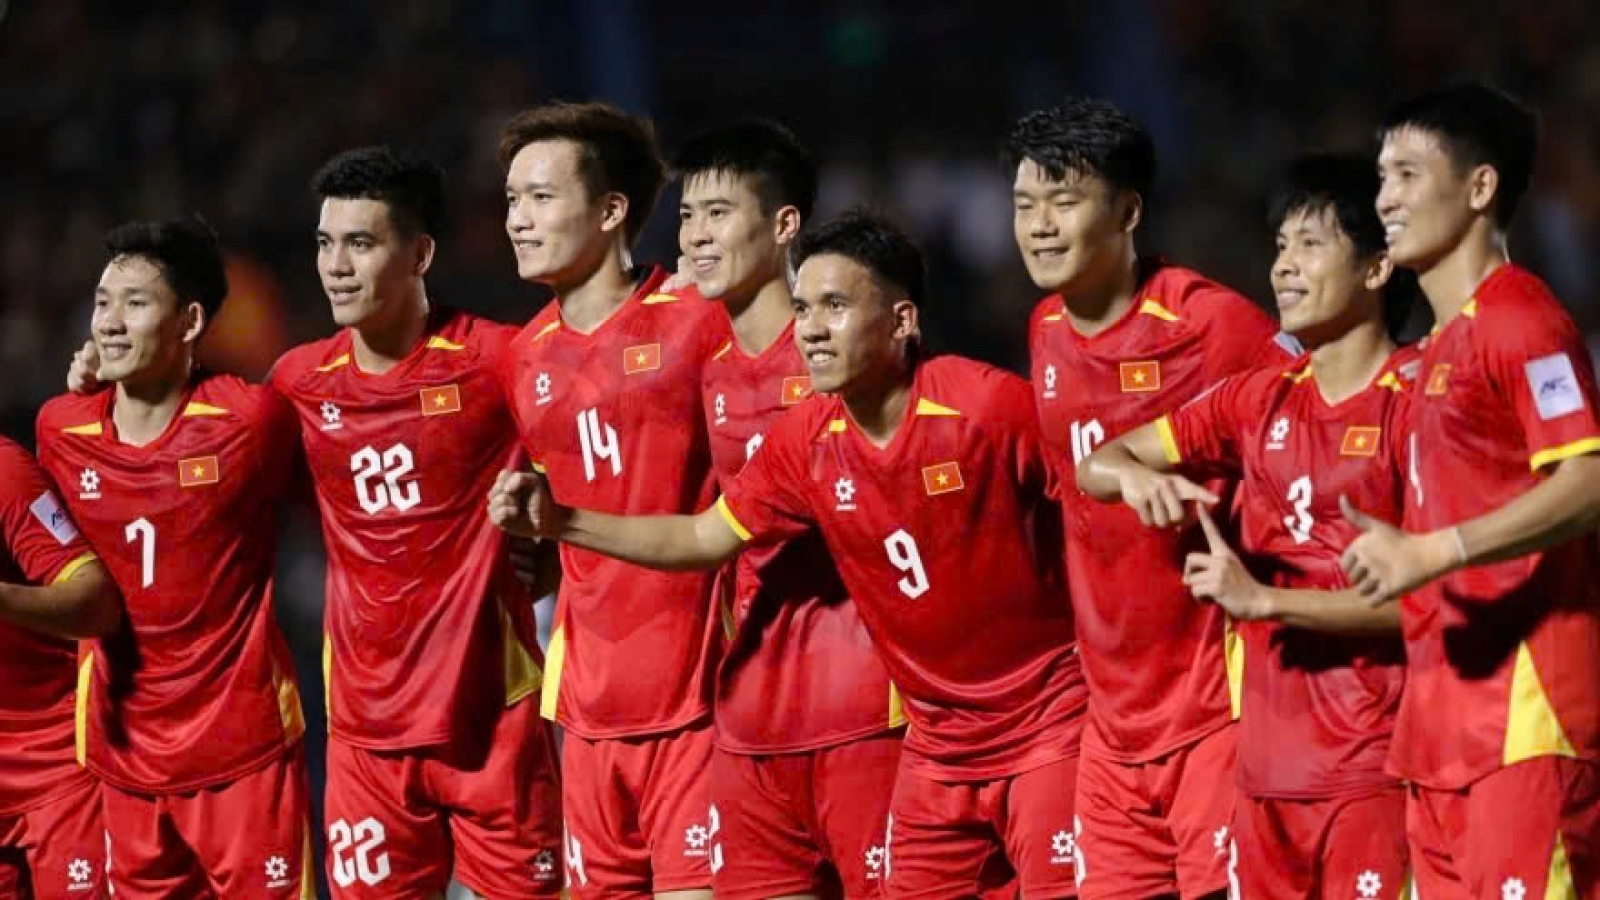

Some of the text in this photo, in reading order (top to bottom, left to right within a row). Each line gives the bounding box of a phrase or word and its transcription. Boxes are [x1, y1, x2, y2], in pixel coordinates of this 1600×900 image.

[350, 442, 421, 516] 22
[576, 407, 623, 482] 14
[1282, 475, 1315, 545] 3
[125, 517, 156, 588] 7
[884, 528, 930, 599] 9
[328, 816, 390, 888] 22
